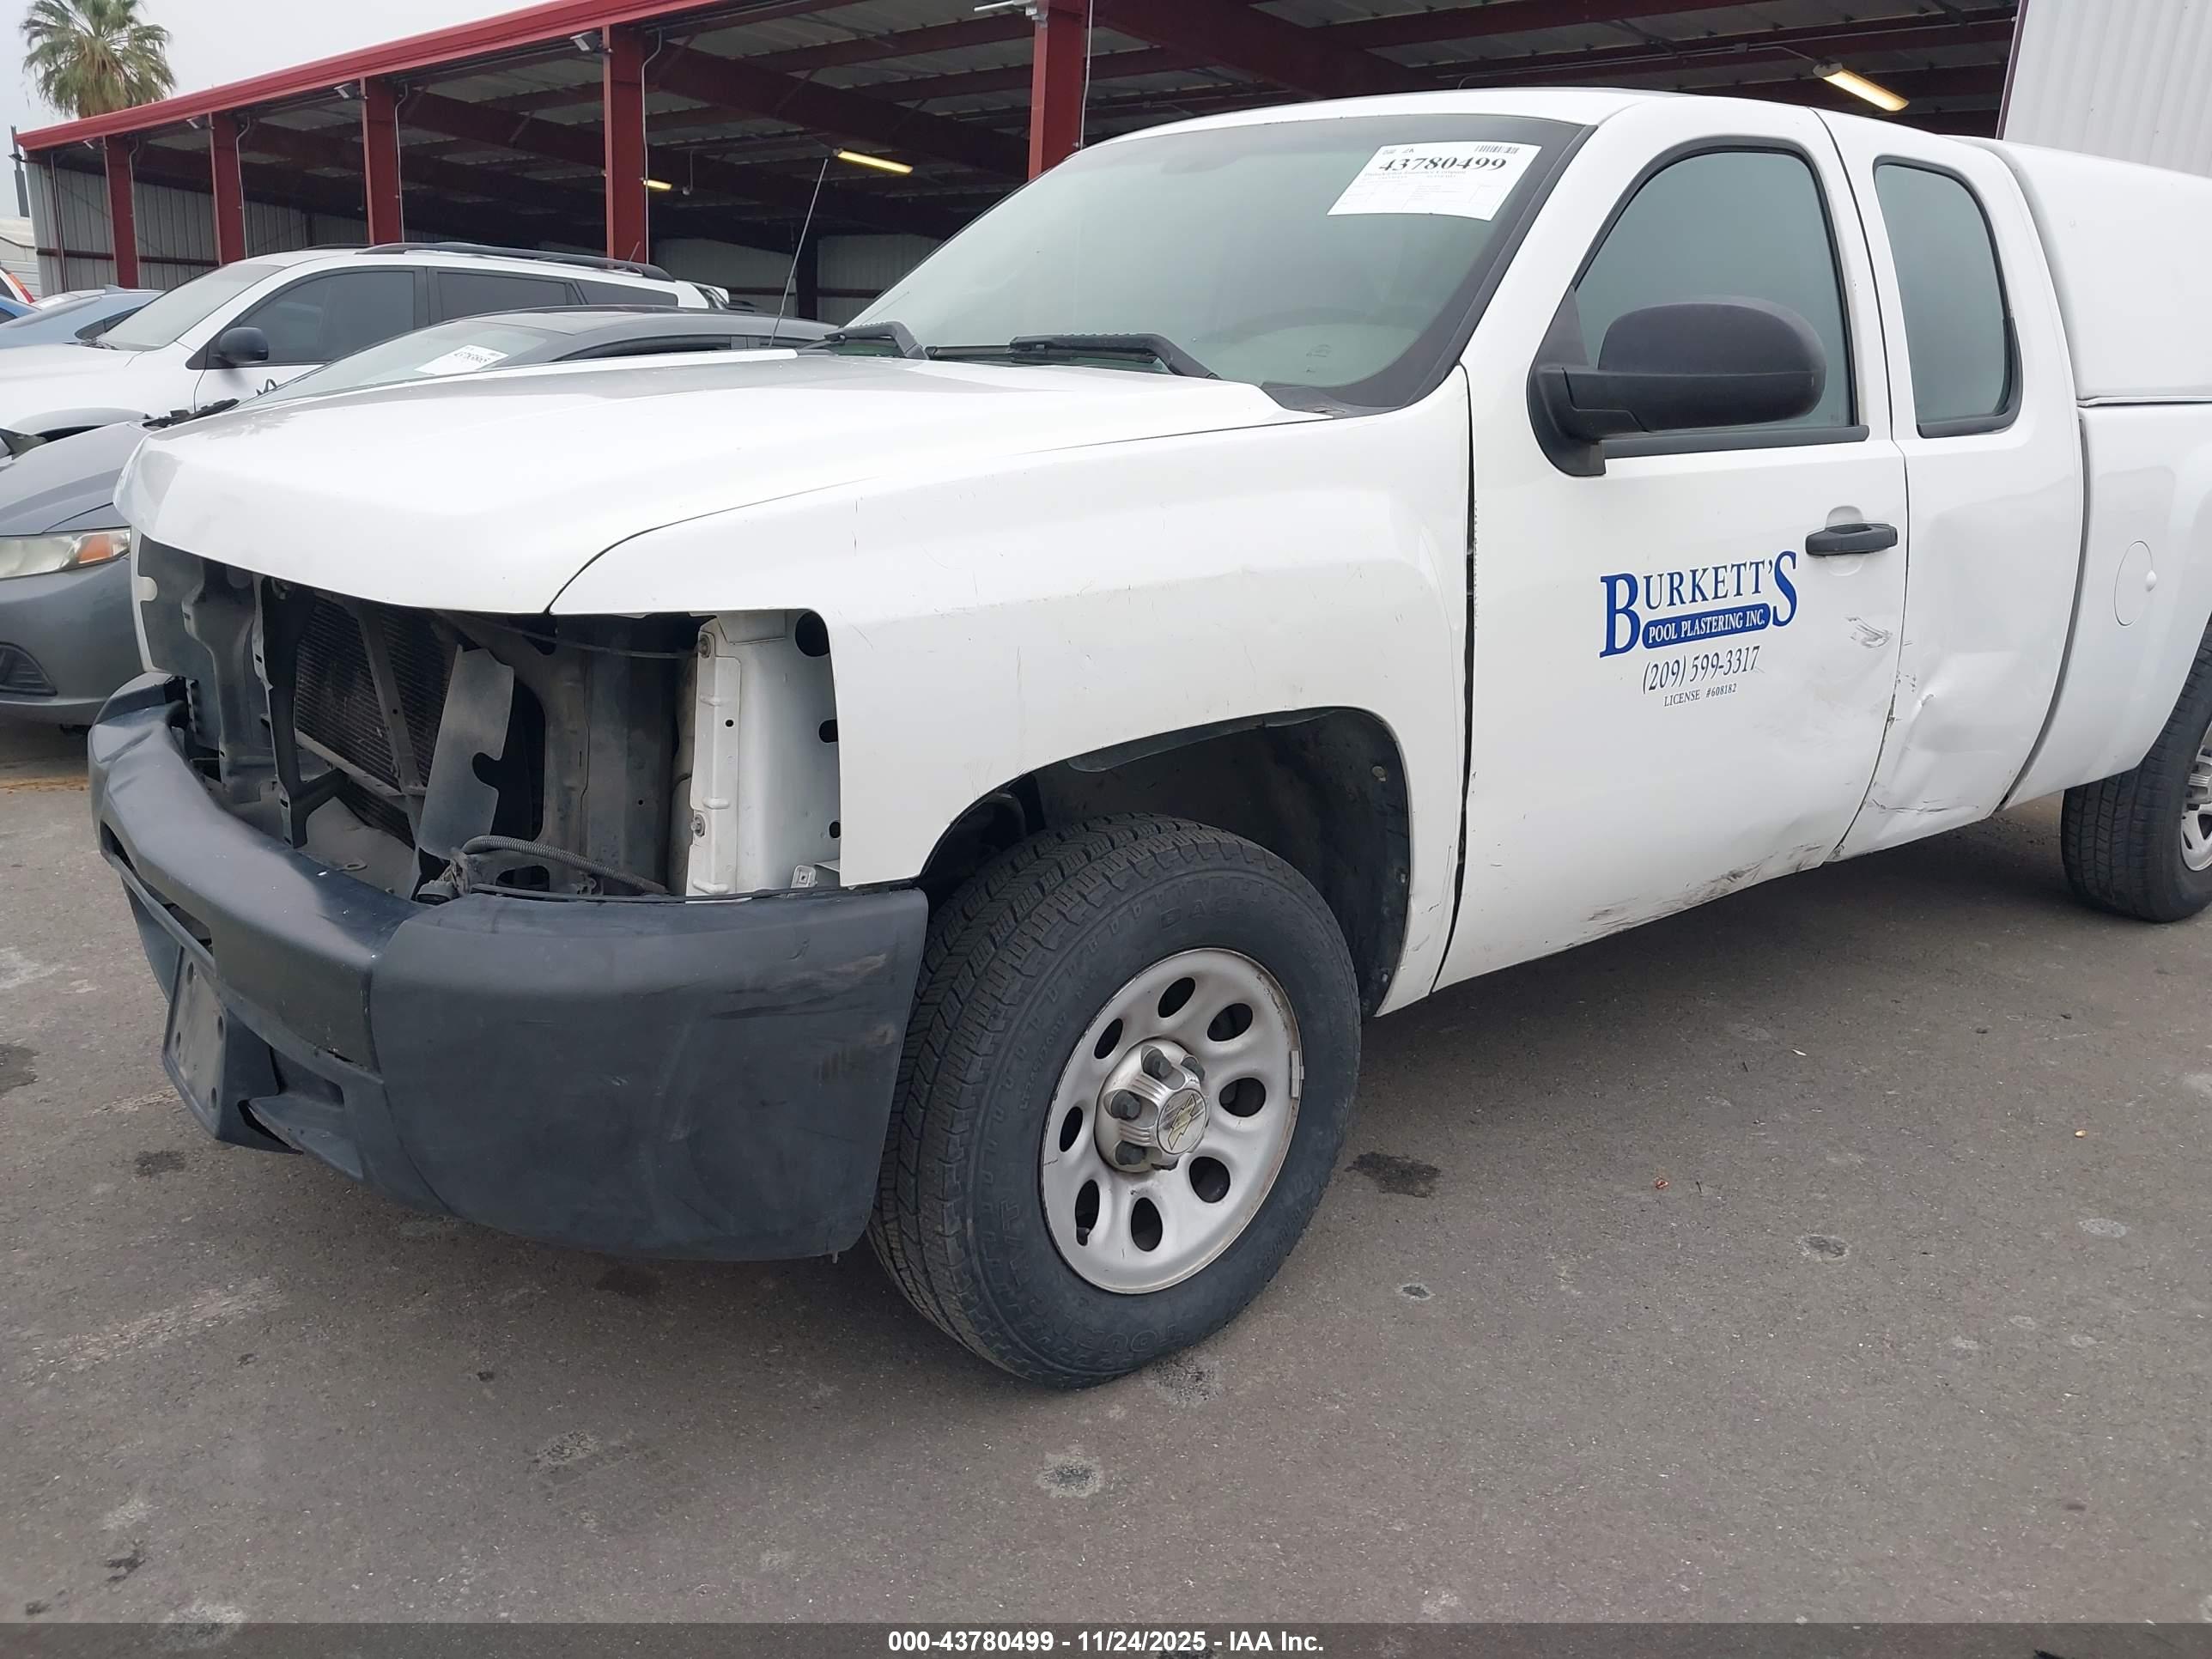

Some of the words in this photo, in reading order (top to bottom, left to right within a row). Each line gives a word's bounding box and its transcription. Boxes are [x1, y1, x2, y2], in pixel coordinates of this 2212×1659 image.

[1379, 156, 1507, 172] 43780499
[1648, 622, 1678, 644] POOL
[1680, 611, 1744, 638] PLASTERING
[1745, 608, 1765, 628] INC.
[1642, 654, 1687, 695] (209)
[1689, 645, 1760, 683] 599-3317
[1663, 689, 1701, 708] LICENSE
[1705, 683, 1737, 699] #608182
